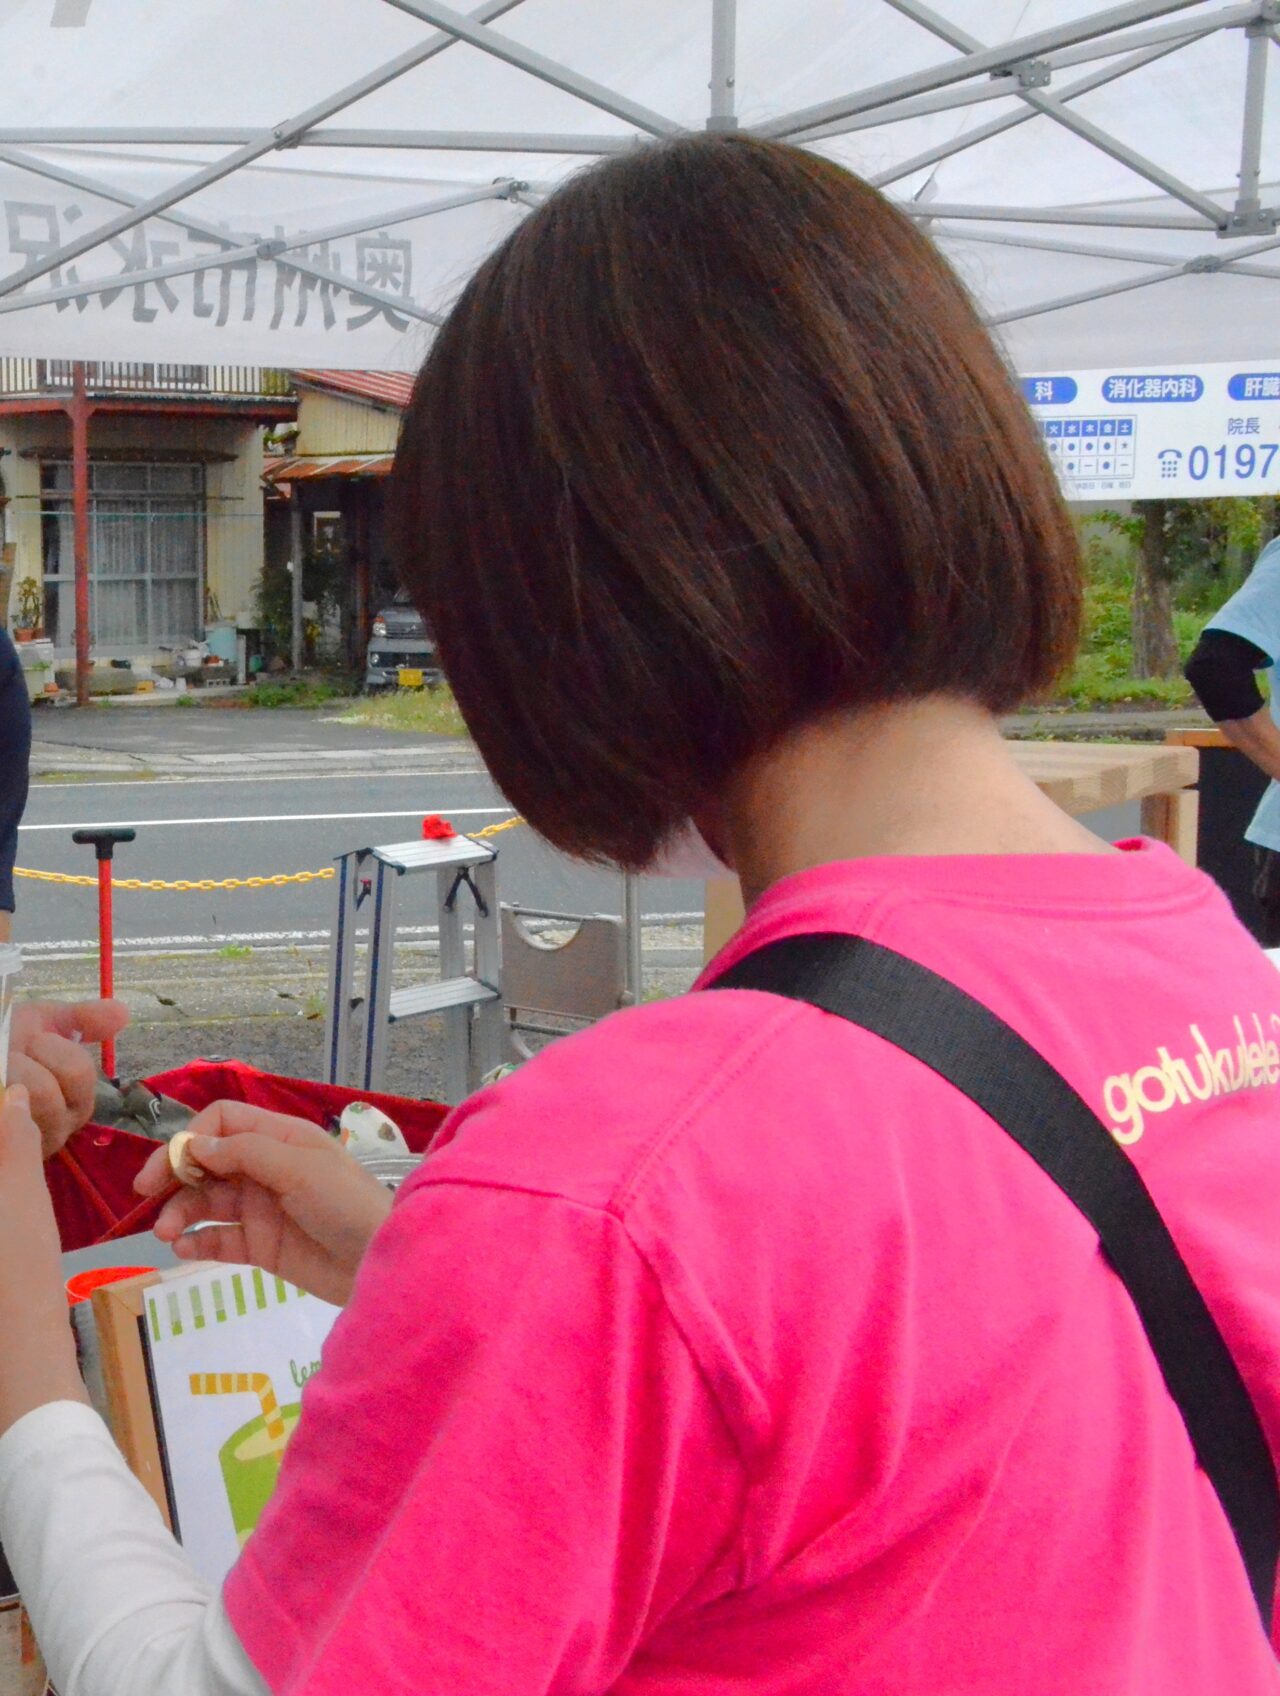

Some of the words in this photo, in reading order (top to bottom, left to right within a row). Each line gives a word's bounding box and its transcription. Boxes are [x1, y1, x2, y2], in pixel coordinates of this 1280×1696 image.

[1108, 377, 1198, 399] 消化器内科
[1227, 416, 1261, 436] 院長
[1188, 443, 1280, 481] 0197
